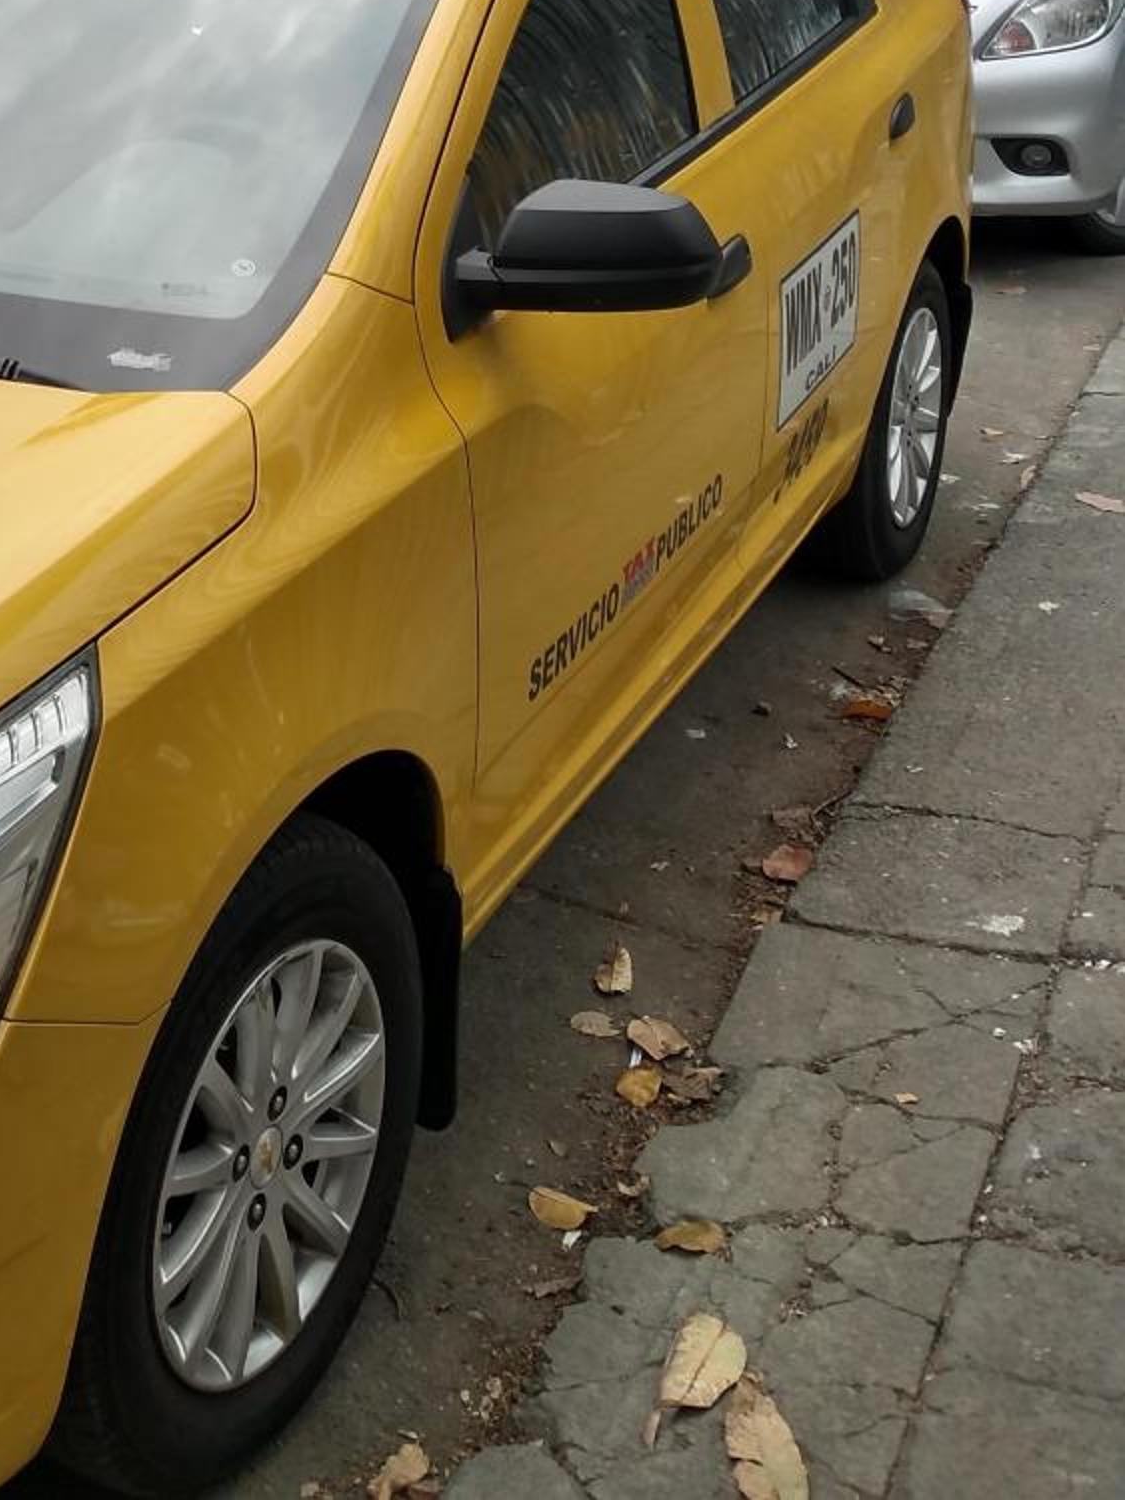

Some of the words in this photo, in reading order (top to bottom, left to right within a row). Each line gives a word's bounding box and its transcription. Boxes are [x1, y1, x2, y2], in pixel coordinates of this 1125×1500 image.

[804, 345, 838, 391] CALI
[528, 583, 620, 701] SERVICIO
[655, 473, 723, 572] PUBLICO
